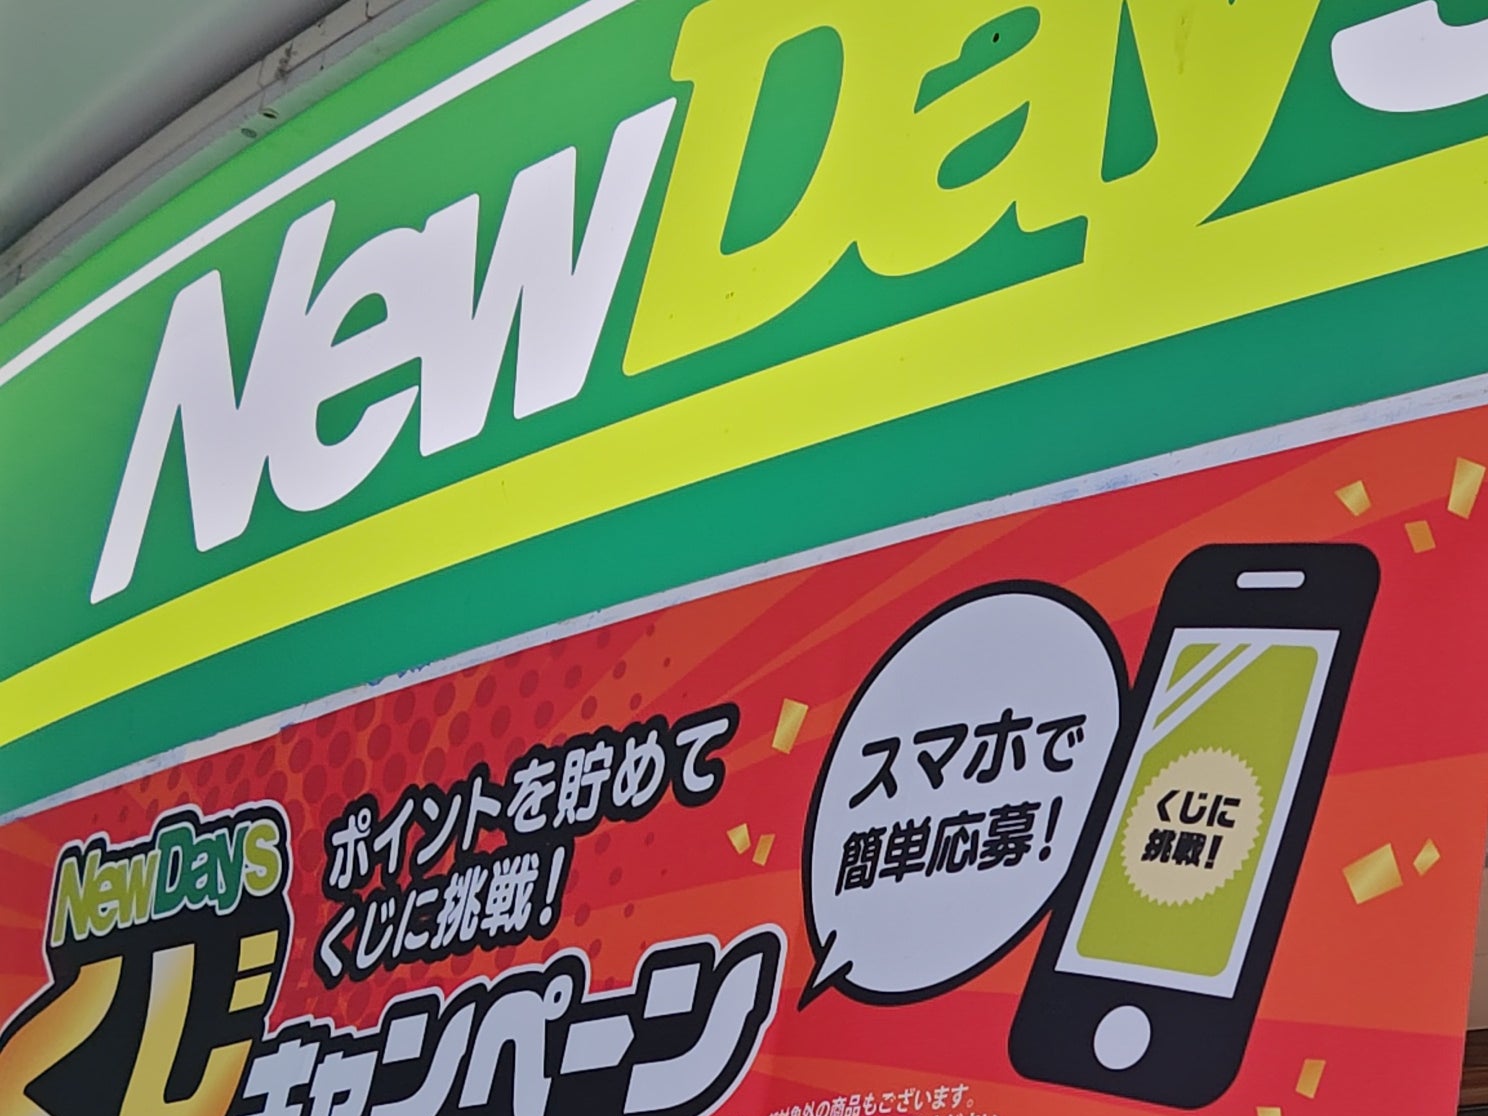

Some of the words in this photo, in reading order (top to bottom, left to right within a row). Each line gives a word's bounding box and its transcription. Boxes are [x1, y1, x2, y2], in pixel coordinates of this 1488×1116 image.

[330, 717, 731, 888] ポイントを貯めて
[848, 708, 1087, 809] スマホで
[1155, 789, 1241, 829] くじに
[52, 815, 280, 945] NewDays
[835, 795, 1064, 896] 簡単応募!
[1141, 827, 1221, 870] 挑戦!
[316, 845, 566, 978] くじに挑戦!
